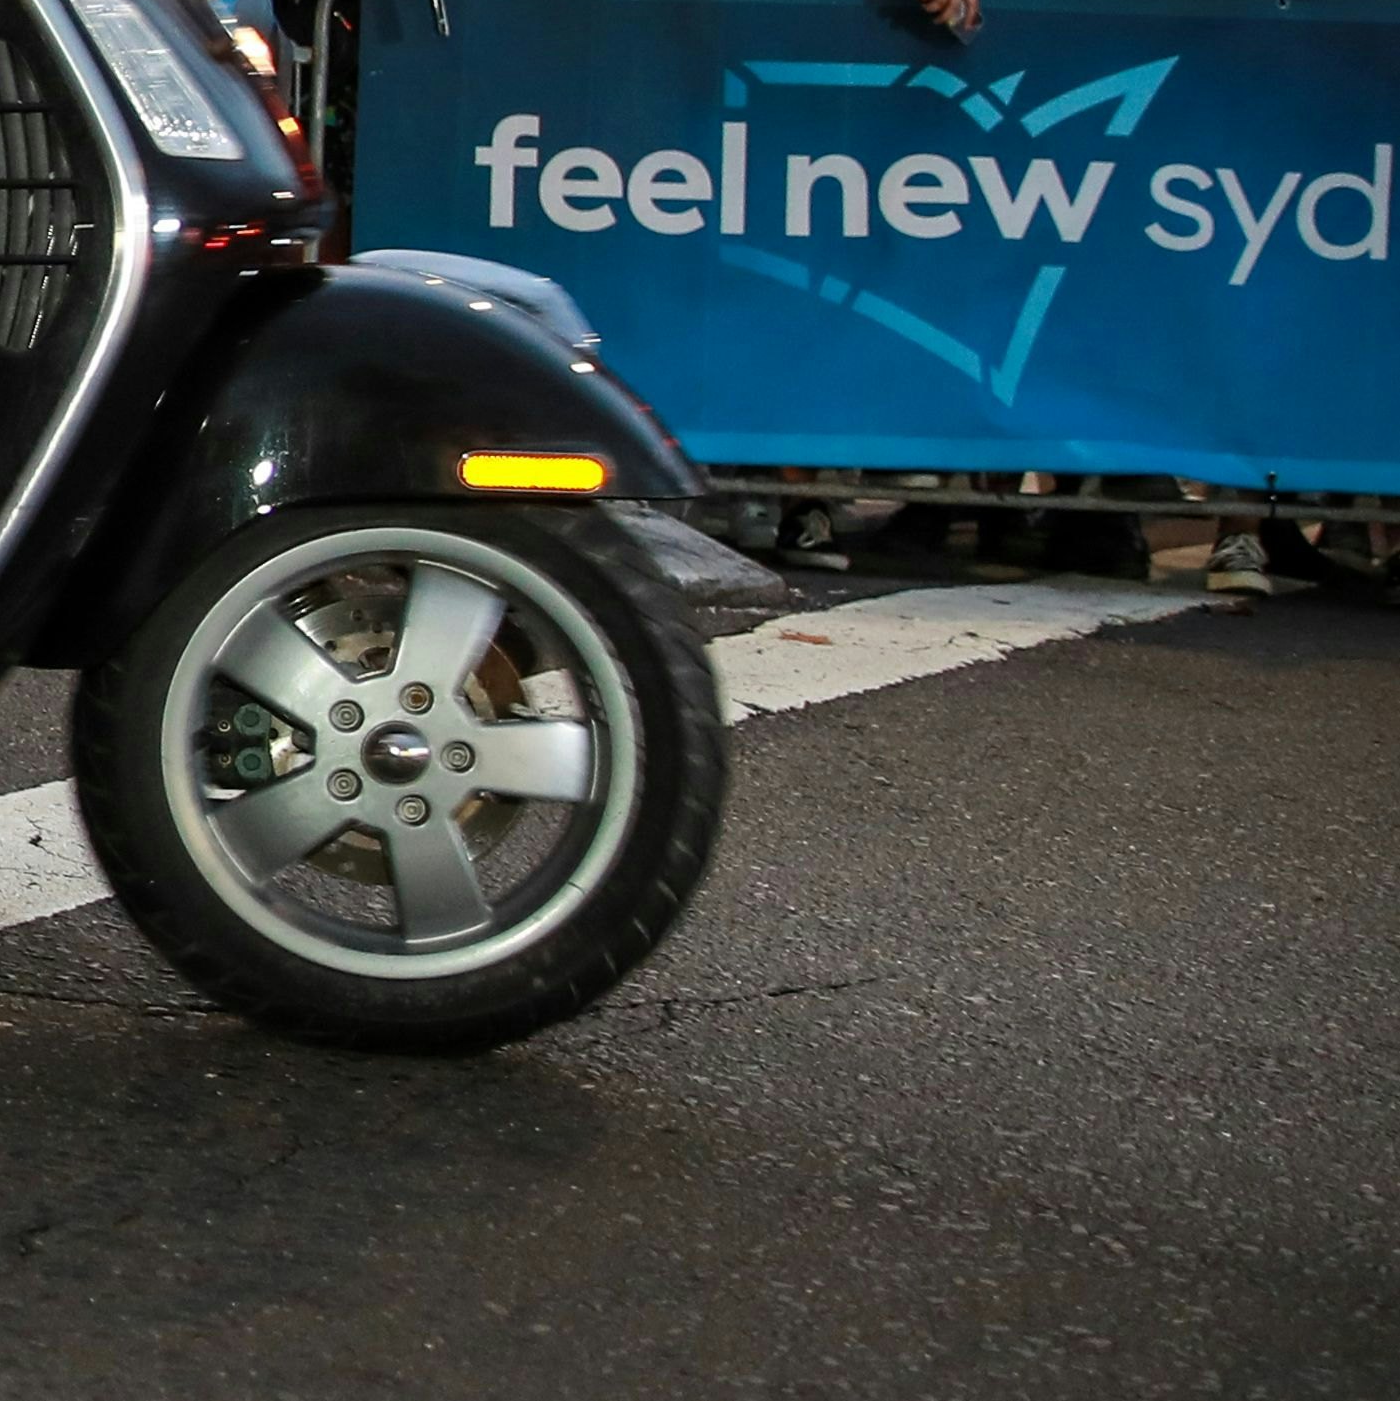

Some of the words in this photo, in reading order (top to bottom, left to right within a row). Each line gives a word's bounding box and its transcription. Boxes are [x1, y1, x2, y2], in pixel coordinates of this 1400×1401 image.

[474, 113, 747, 236] feel
[785, 152, 1115, 242] new
[1143, 143, 1395, 286] syd
